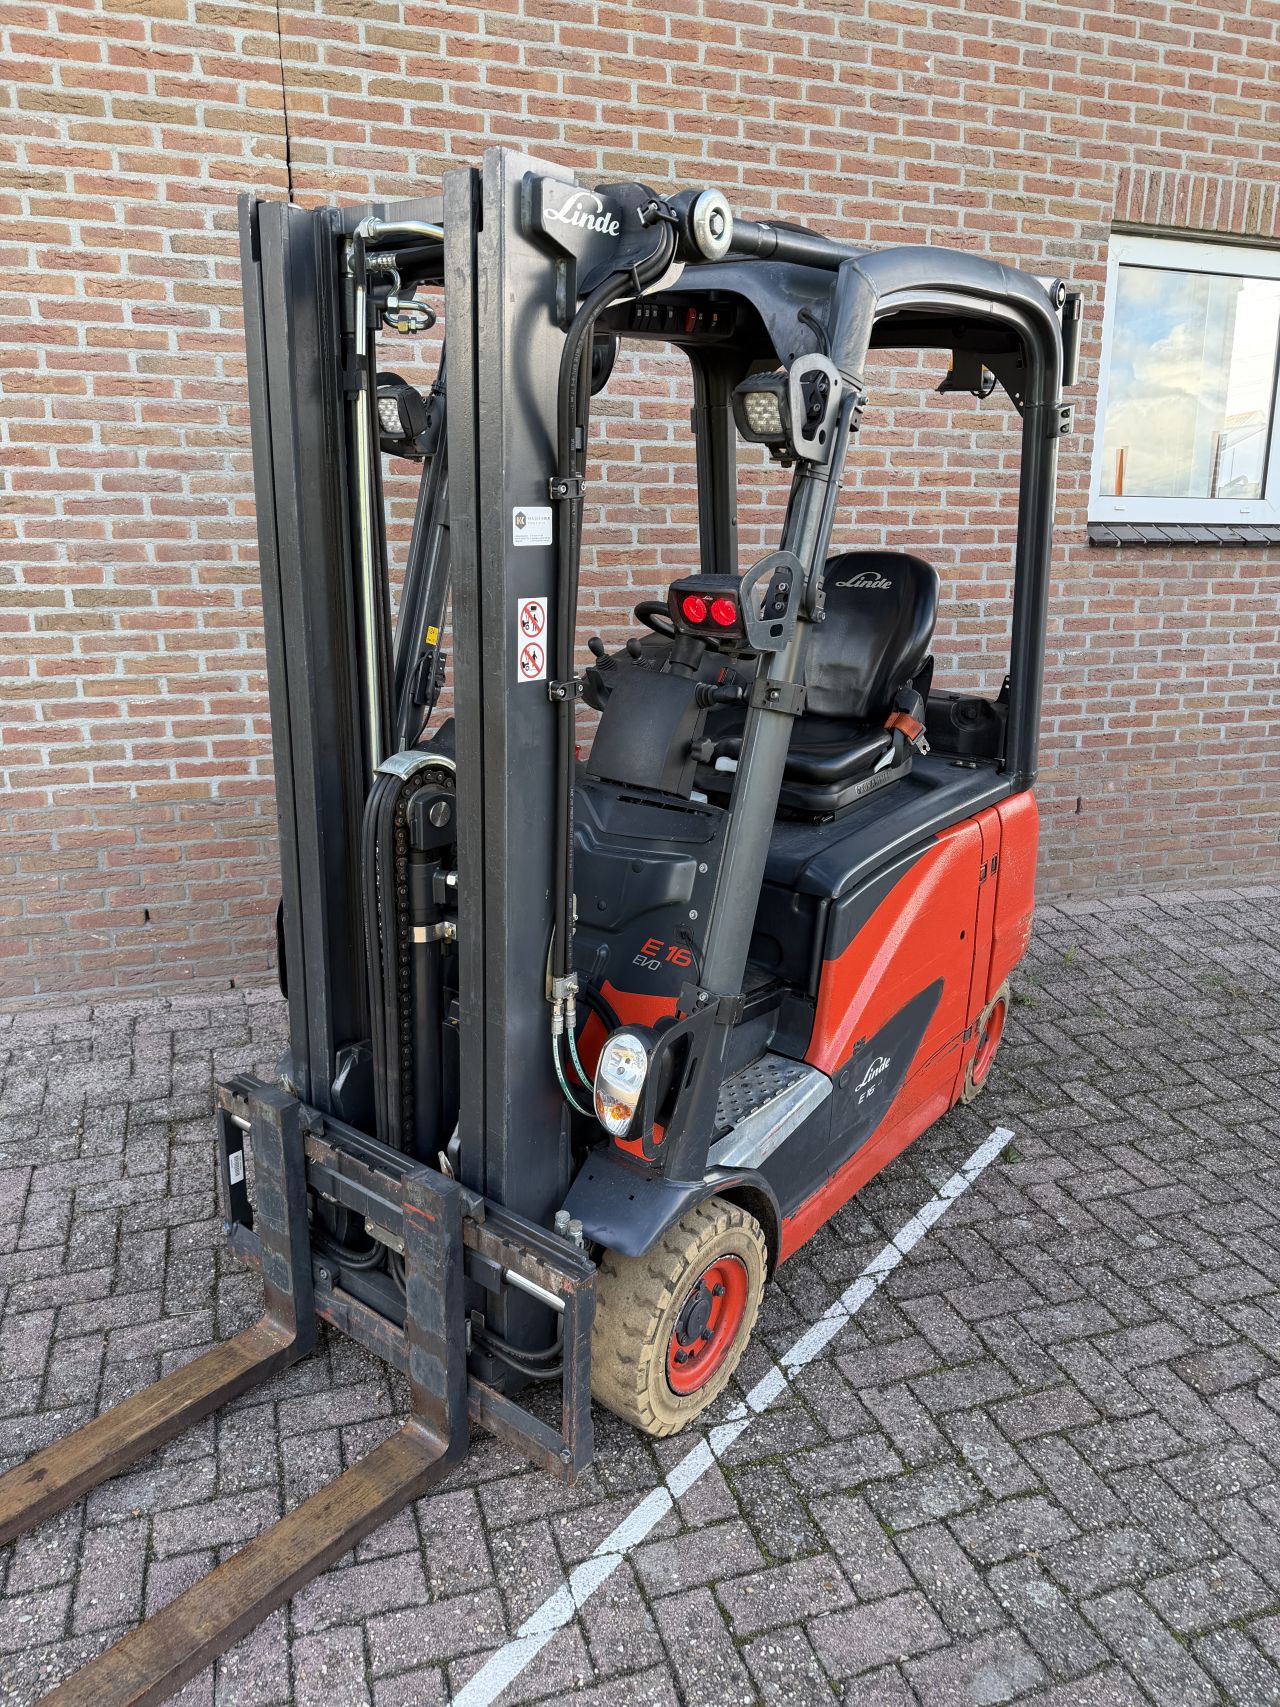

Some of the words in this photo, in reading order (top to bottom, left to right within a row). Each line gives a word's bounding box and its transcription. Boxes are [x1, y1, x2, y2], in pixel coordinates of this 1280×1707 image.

[543, 191, 621, 236] Linde
[835, 571, 893, 589] Linde
[632, 954, 661, 971] EVO
[641, 937, 665, 957] E
[665, 945, 692, 967] 16
[854, 1056, 891, 1092] Linde
